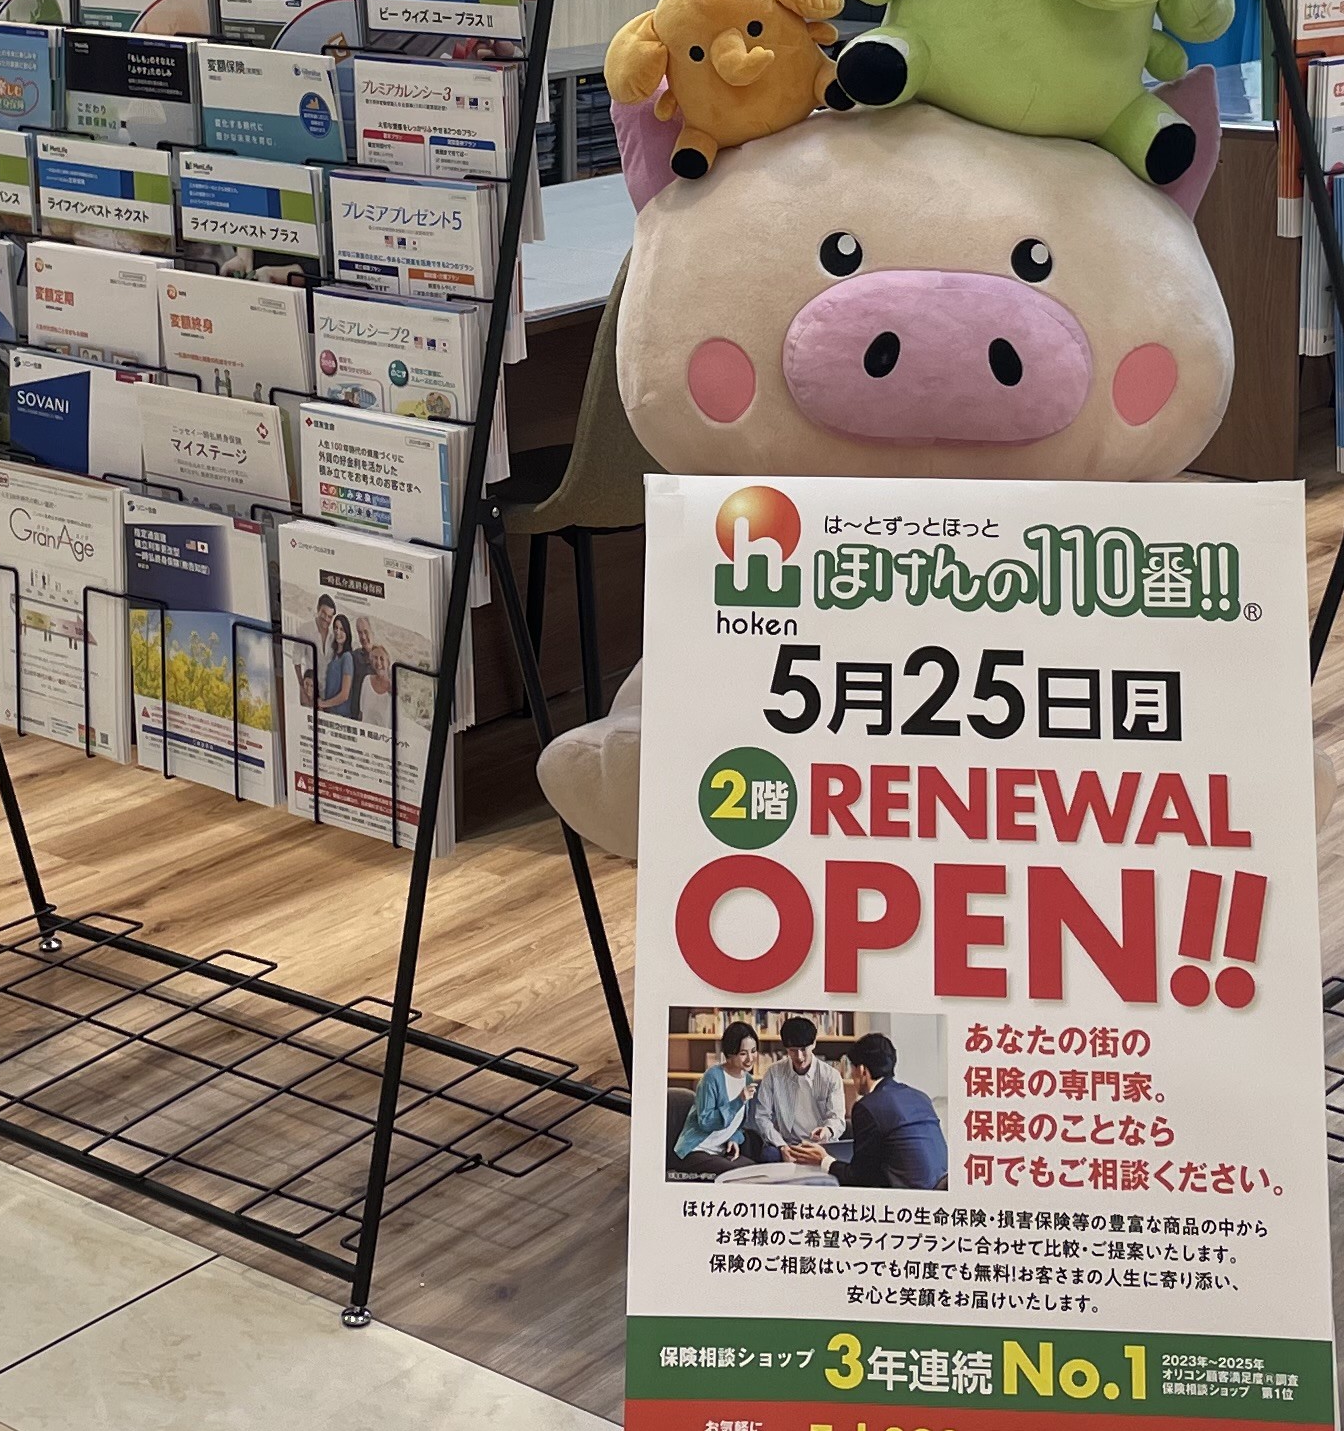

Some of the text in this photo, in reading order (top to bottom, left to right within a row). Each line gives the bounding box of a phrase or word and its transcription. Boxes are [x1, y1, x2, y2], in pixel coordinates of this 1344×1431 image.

[402, 9, 429, 24] ウィズ
[432, 12, 452, 23] ユー
[455, 12, 485, 26] プラス
[207, 59, 245, 74] 変額保険
[362, 80, 451, 101] プレミアカレンシー3
[78, 102, 106, 115] こだわり
[48, 197, 149, 224] ライフインベスト ネクスト
[342, 202, 462, 230] プレミアプレゼント5
[191, 217, 300, 243] ライフインベスト プラス
[319, 316, 410, 344] プレミアレシーブ2
[17, 390, 69, 413] SOVANI
[171, 439, 247, 464] マイステージ
[319, 451, 398, 476] 外貨の好金利を活かした
[319, 465, 421, 493] 積み立てをお考えのお客さまへ
[716, 610, 798, 636] hoken
[708, 762, 1252, 849] 2階 RENEWAL
[675, 853, 1268, 1008] OPEN!!
[964, 1023, 1151, 1058] あなたの街の
[964, 1065, 1165, 1103] 保険の専門家。
[964, 1109, 1175, 1147] 保険のことなら
[964, 1153, 1283, 1196] 何でもご相談ください。
[683, 1200, 1268, 1237] ほけんの110番は40社以上の生命保険・損害保険等の豊富な商品の中から
[716, 1228, 1237, 1264] お客様のご希望やライフプランに合わせて比較・ご提案いたします。
[847, 1286, 1099, 1313] 安心と笑顔をお届けいたします。
[660, 1333, 1146, 1400] 保険相談ショップ 3年連続 No.1
[1162, 1383, 1294, 1401] 保険相談ショップ 第1位
